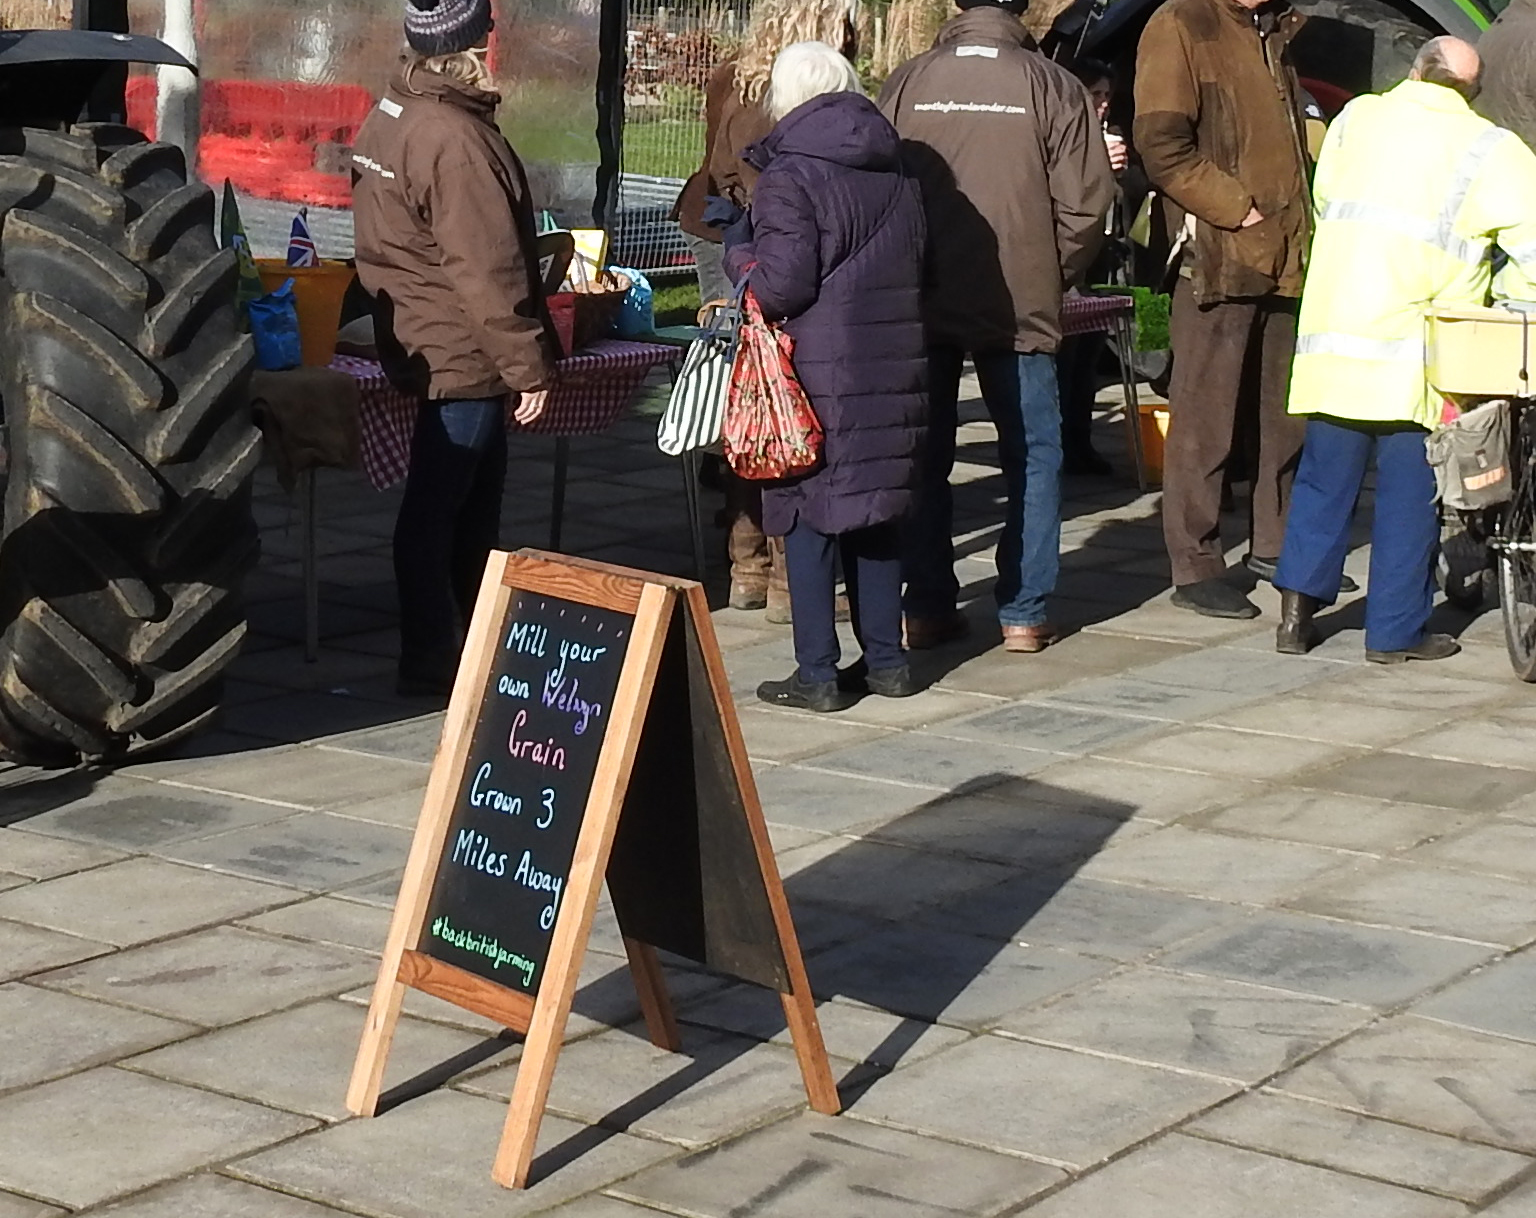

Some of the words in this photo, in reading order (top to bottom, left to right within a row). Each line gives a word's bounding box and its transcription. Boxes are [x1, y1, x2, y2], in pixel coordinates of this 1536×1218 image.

[498, 675, 530, 699] own
[506, 622, 548, 658] Mill
[550, 639, 606, 688] your
[509, 709, 565, 770] Grain
[470, 762, 522, 816] Grown
[536, 788, 555, 829] 3
[452, 829, 509, 877] Miles
[514, 851, 563, 930] Away
